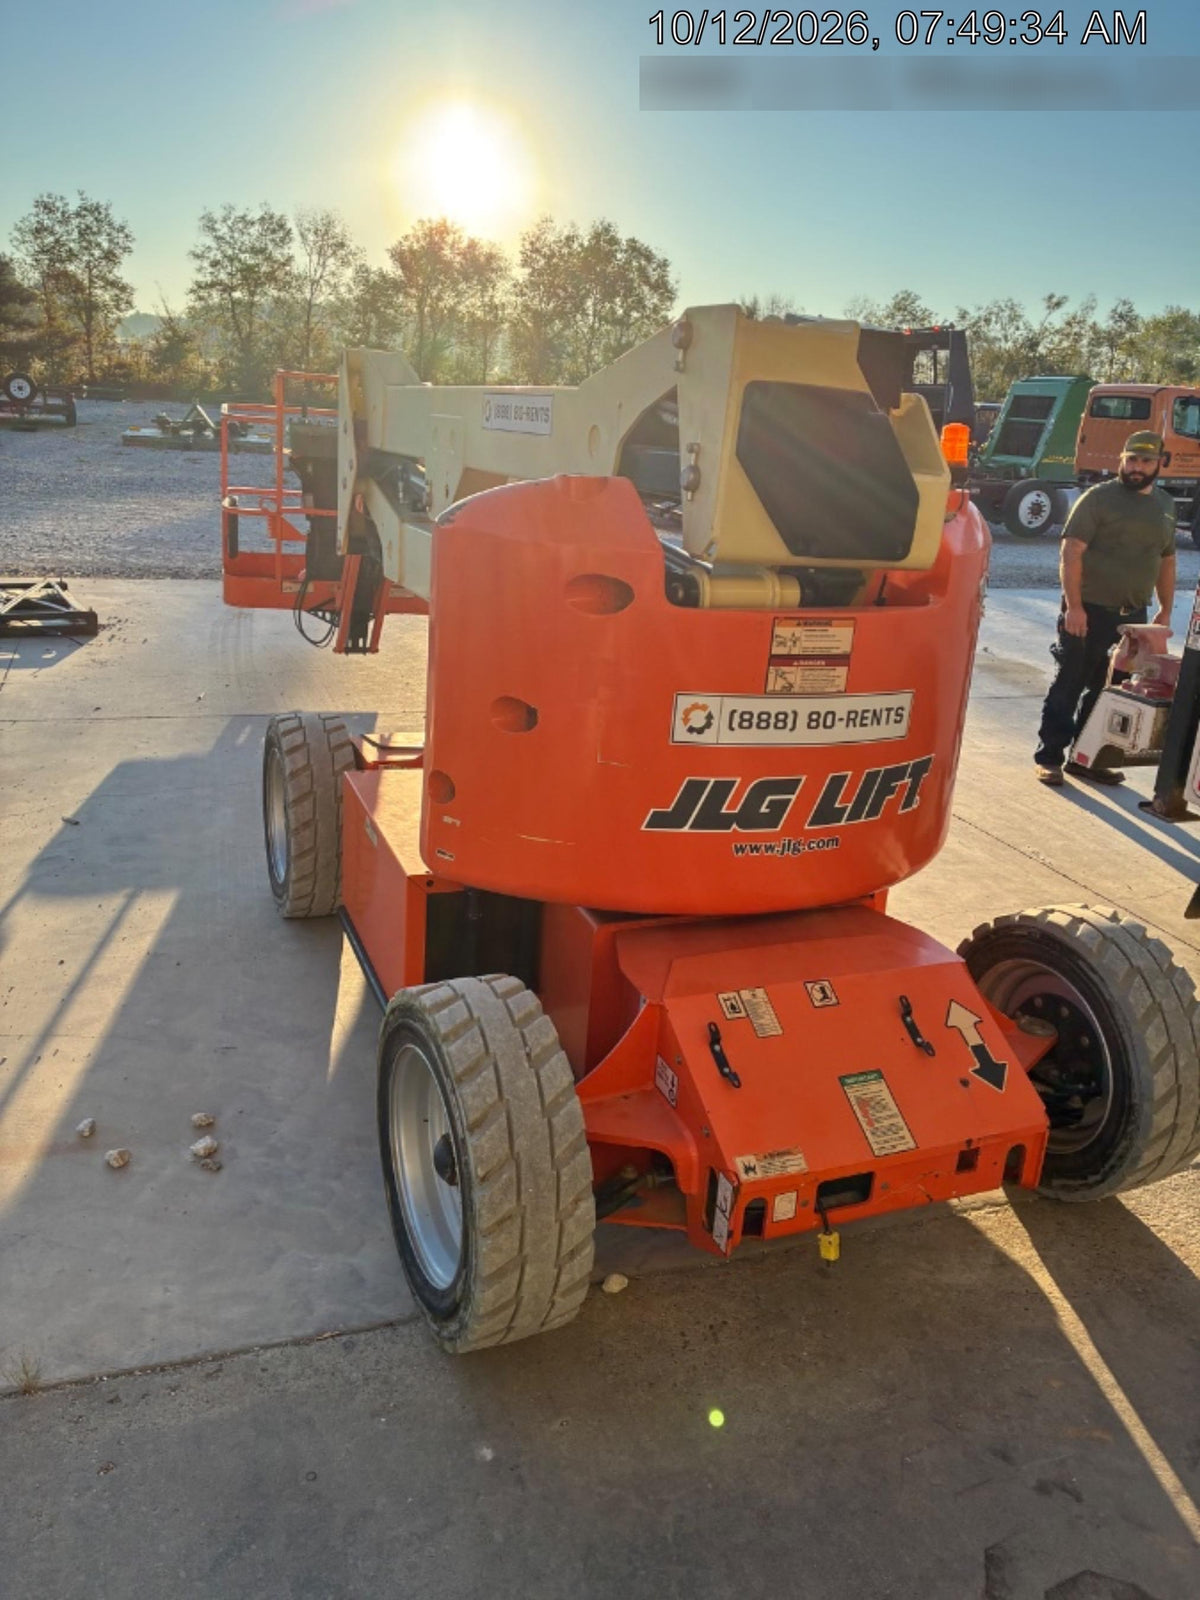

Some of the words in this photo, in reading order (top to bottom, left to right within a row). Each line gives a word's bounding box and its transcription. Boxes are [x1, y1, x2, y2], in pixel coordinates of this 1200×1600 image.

[728, 708, 798, 731] (888)
[806, 706, 905, 730] 80-RENTS
[642, 776, 806, 832] JLG
[805, 753, 935, 829] LIFT
[733, 835, 840, 856] www.jlg.com
